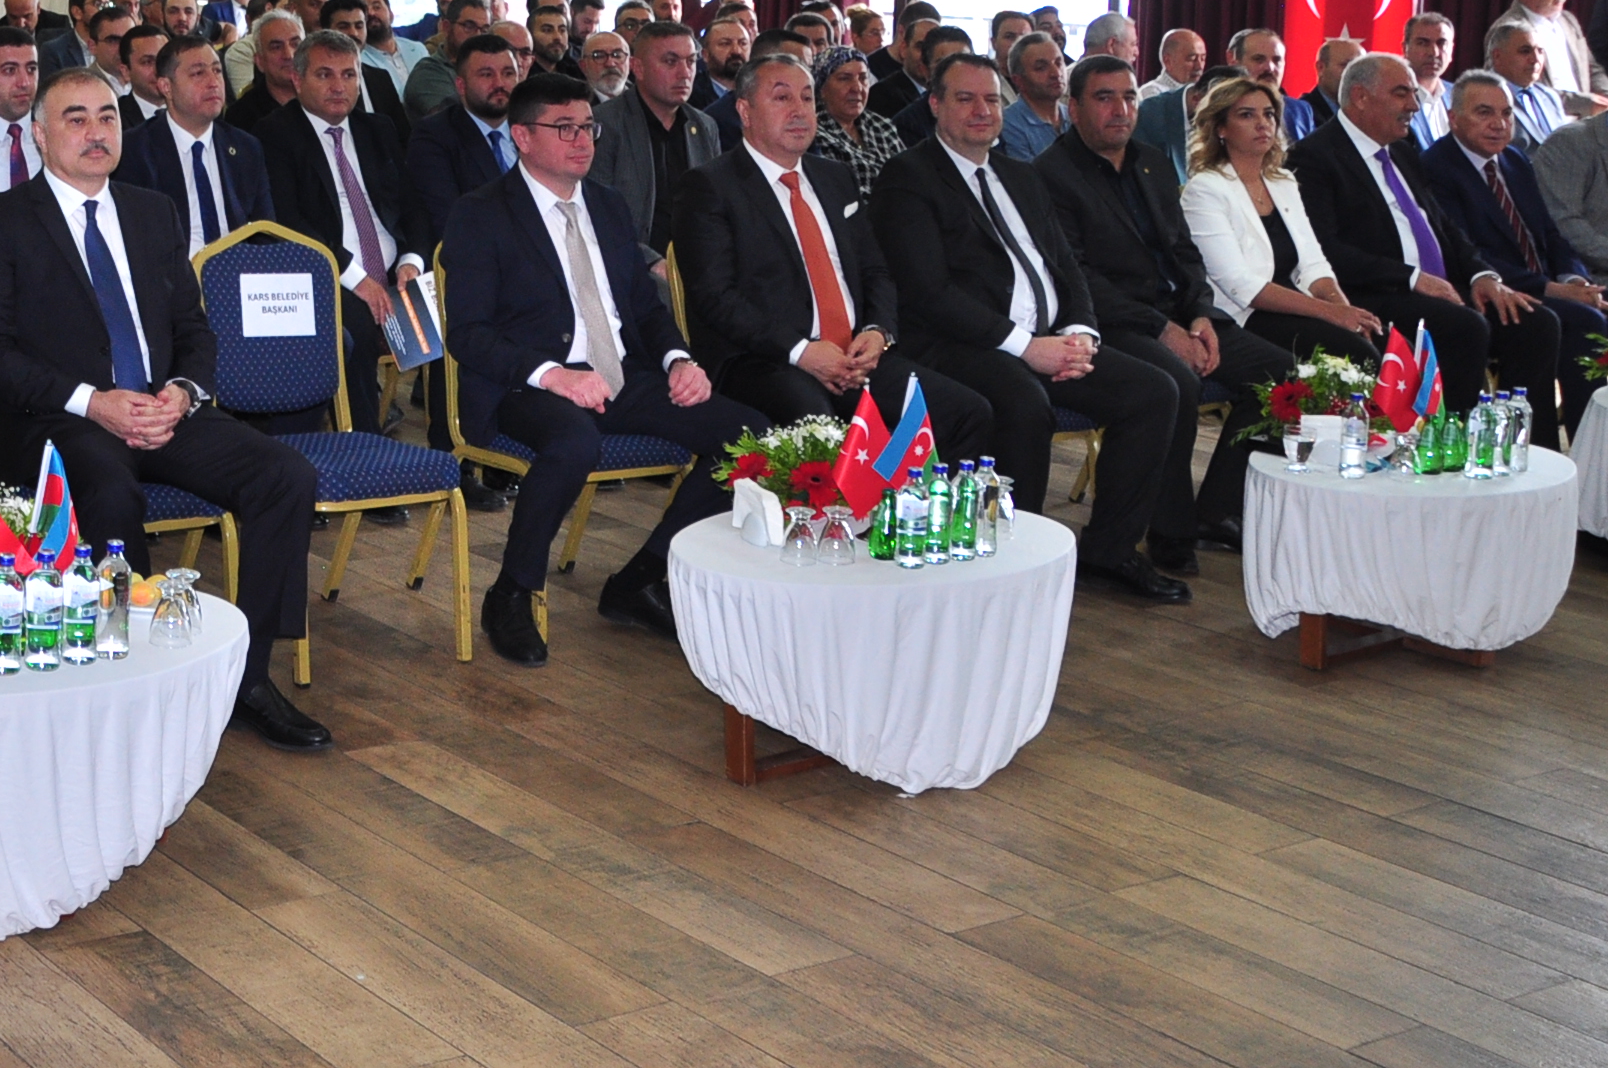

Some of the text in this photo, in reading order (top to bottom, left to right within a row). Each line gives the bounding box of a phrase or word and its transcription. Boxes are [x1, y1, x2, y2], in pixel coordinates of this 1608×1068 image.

[248, 292, 309, 301] KARS BELEDİYE
[262, 306, 298, 315] BAŞKANI
